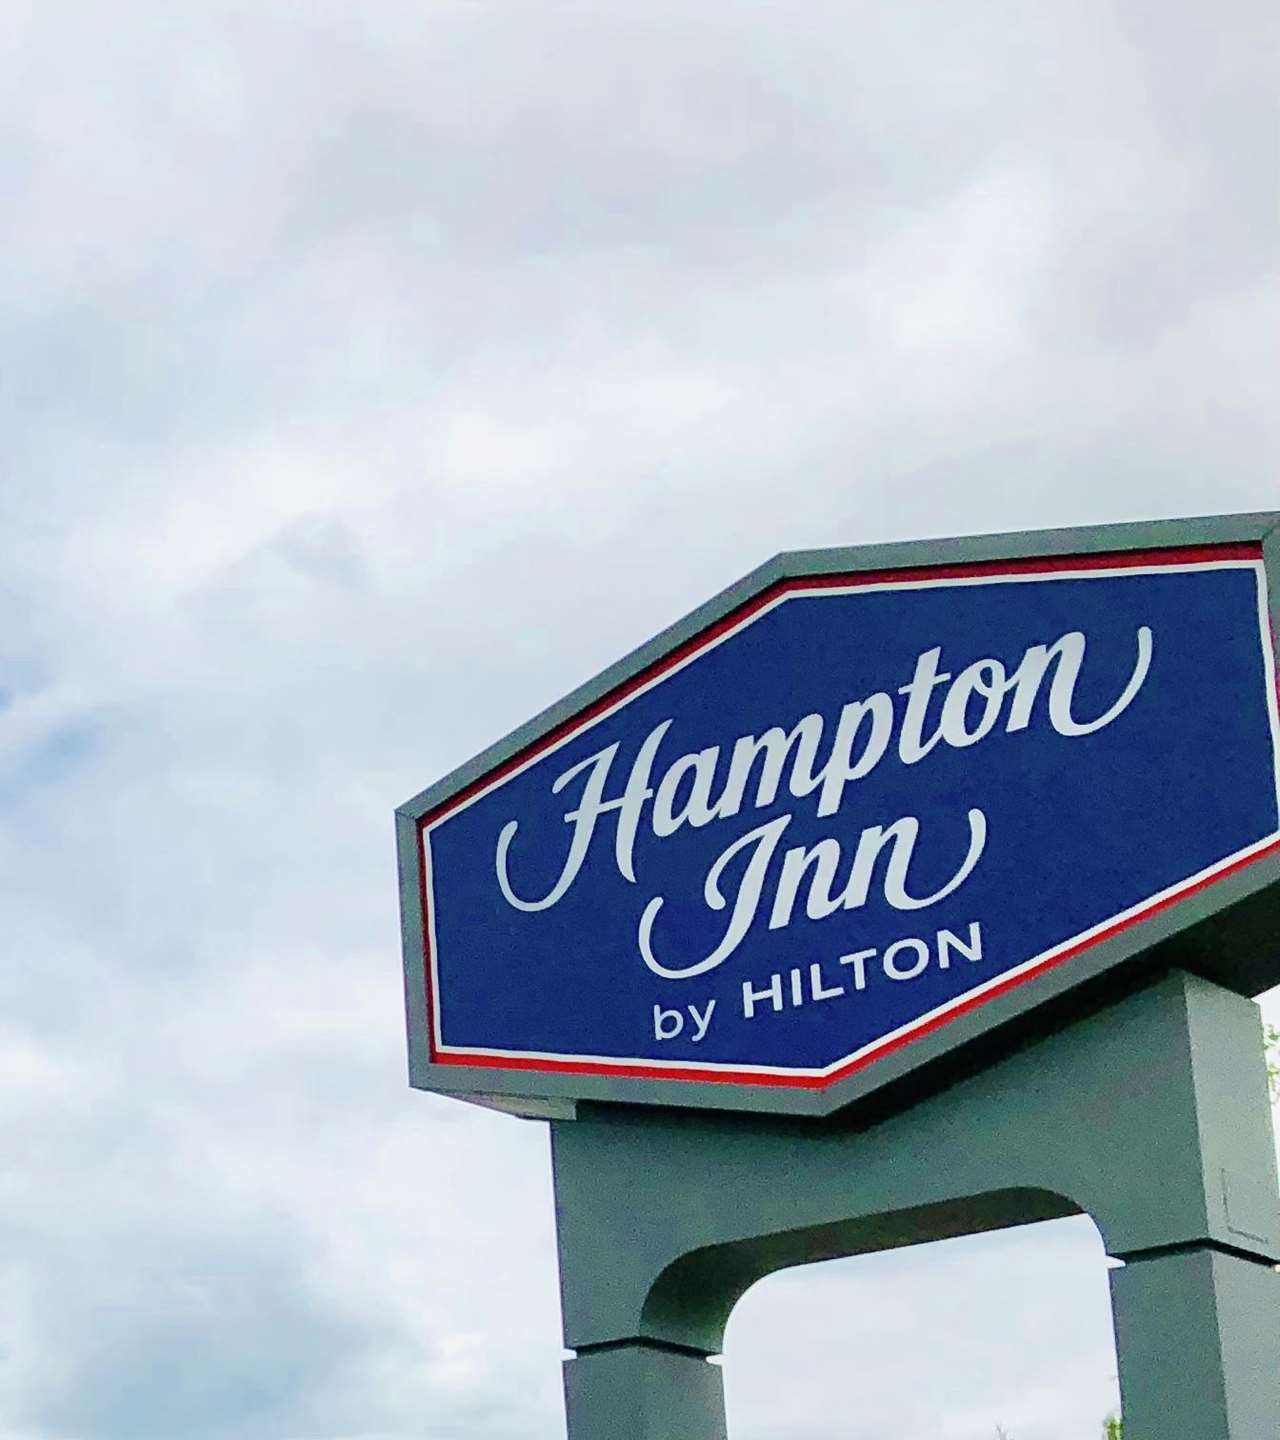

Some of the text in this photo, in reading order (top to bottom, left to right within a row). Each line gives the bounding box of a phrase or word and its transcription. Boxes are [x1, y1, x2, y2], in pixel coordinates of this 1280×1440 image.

[496, 627, 1152, 911] Hampton
[639, 809, 986, 978] Inn
[654, 922, 983, 1042] by HILTON
